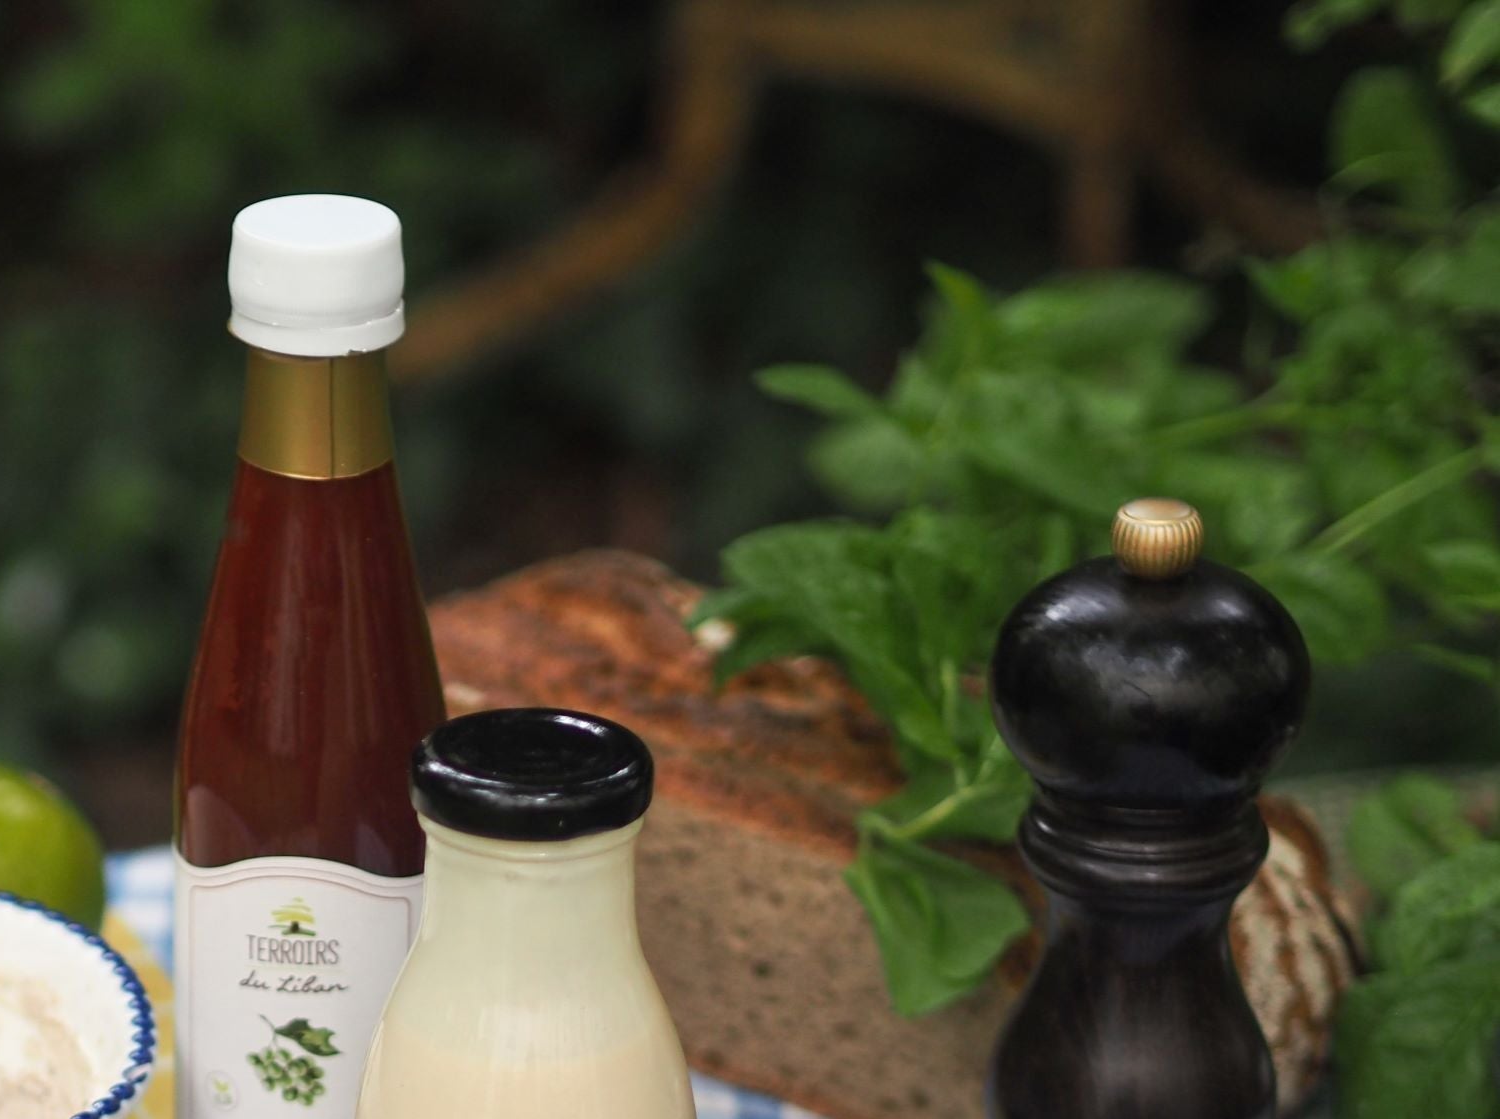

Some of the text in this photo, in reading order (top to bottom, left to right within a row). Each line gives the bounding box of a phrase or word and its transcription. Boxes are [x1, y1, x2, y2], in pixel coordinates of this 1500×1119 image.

[246, 934, 340, 965] TERROIRS
[239, 969, 350, 993] du Liban
